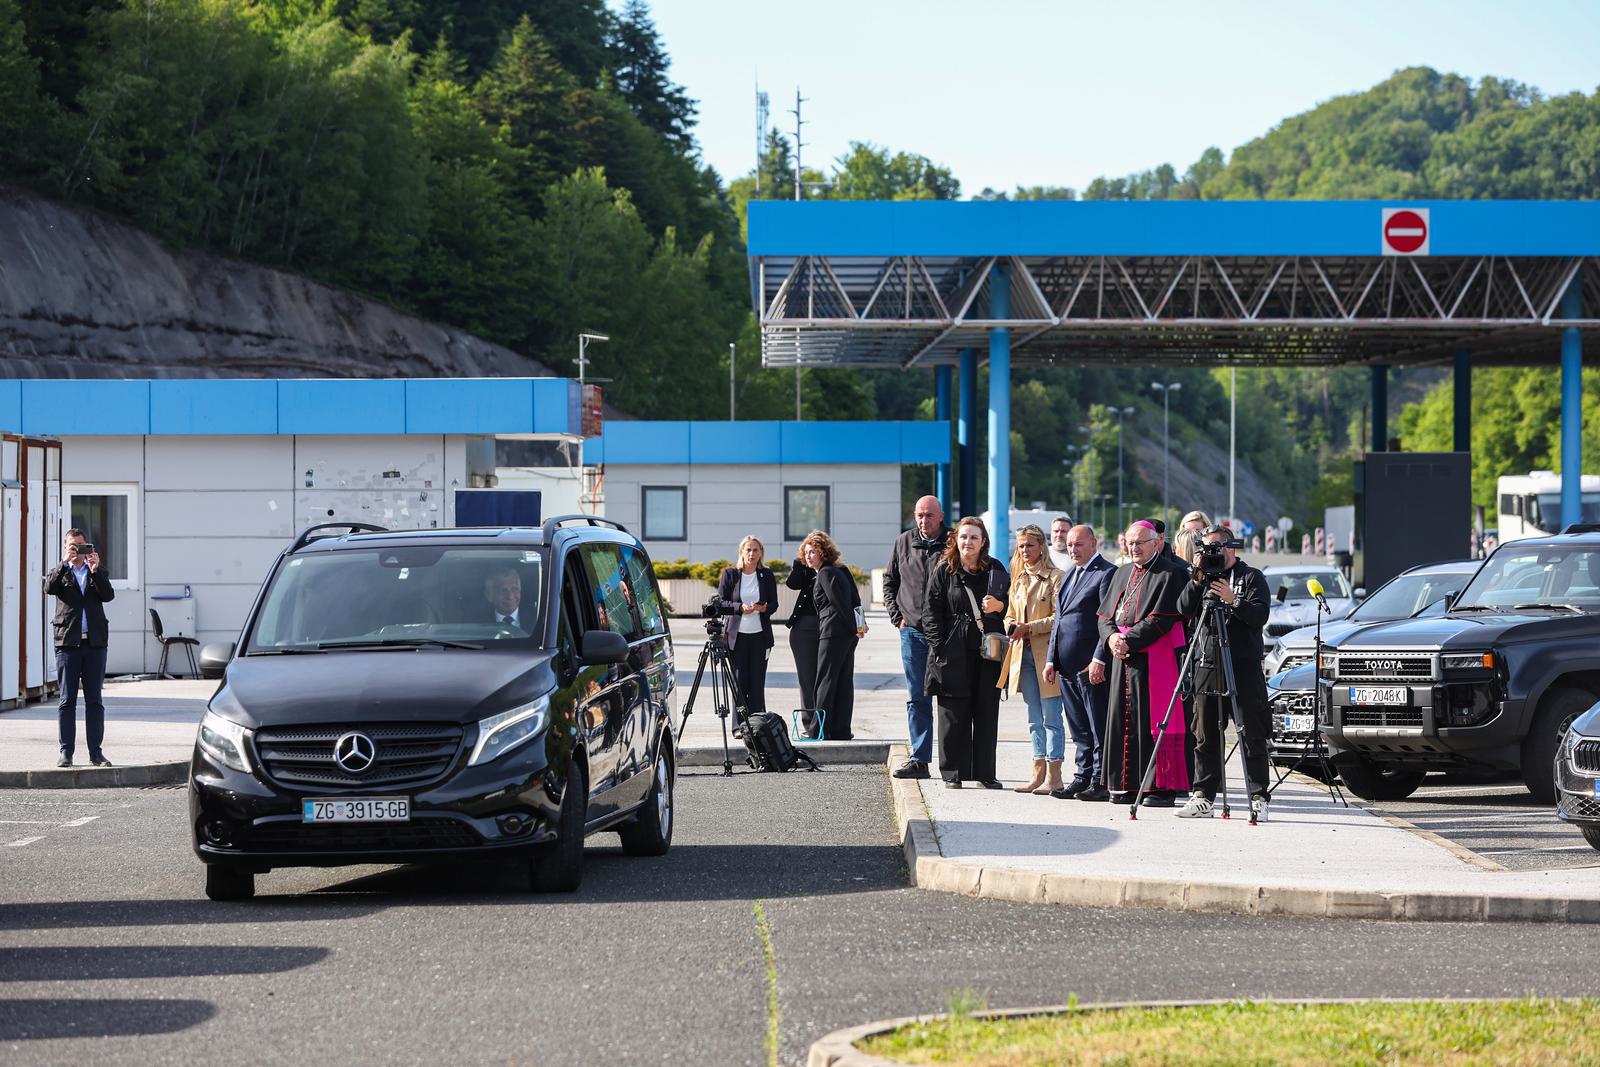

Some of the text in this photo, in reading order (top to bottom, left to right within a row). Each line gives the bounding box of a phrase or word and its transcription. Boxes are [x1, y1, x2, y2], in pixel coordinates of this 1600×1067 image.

[1365, 661, 1403, 669] TOYOTA
[1356, 689, 1367, 702] ZG
[1291, 718, 1301, 730] ZG
[315, 802, 335, 820] ZG
